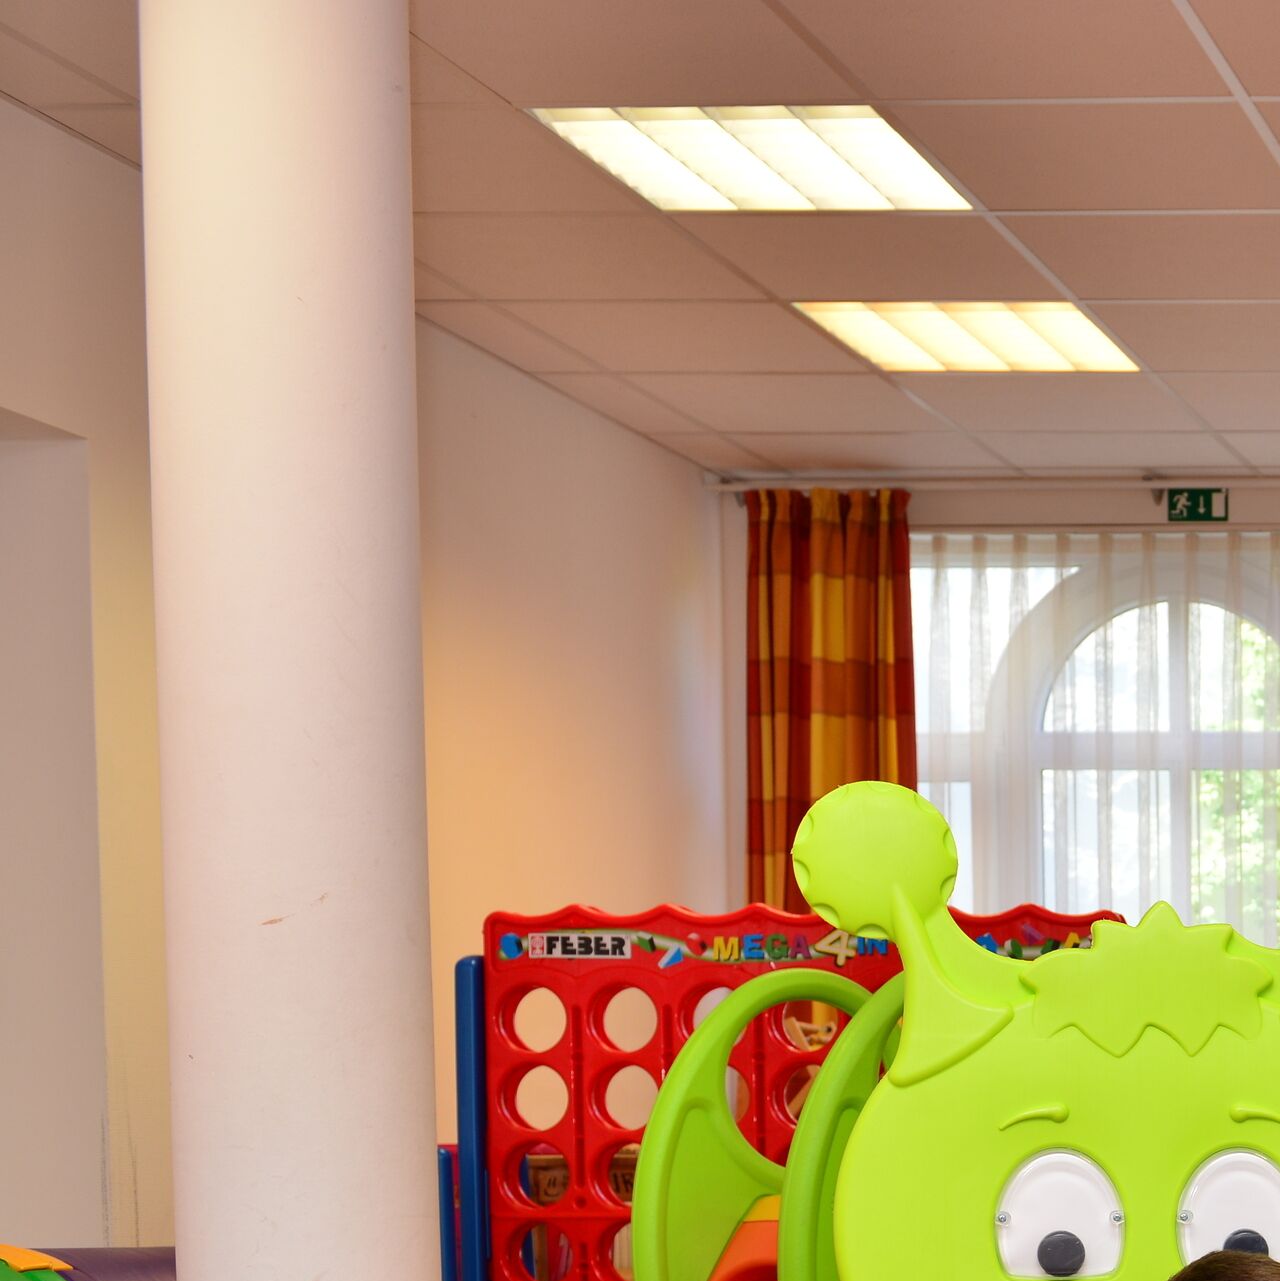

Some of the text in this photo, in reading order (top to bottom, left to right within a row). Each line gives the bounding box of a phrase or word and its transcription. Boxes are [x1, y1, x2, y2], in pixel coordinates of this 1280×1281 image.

[546, 935, 626, 957] FEBER
[712, 933, 813, 962] MEGA
[814, 930, 857, 967] 4
